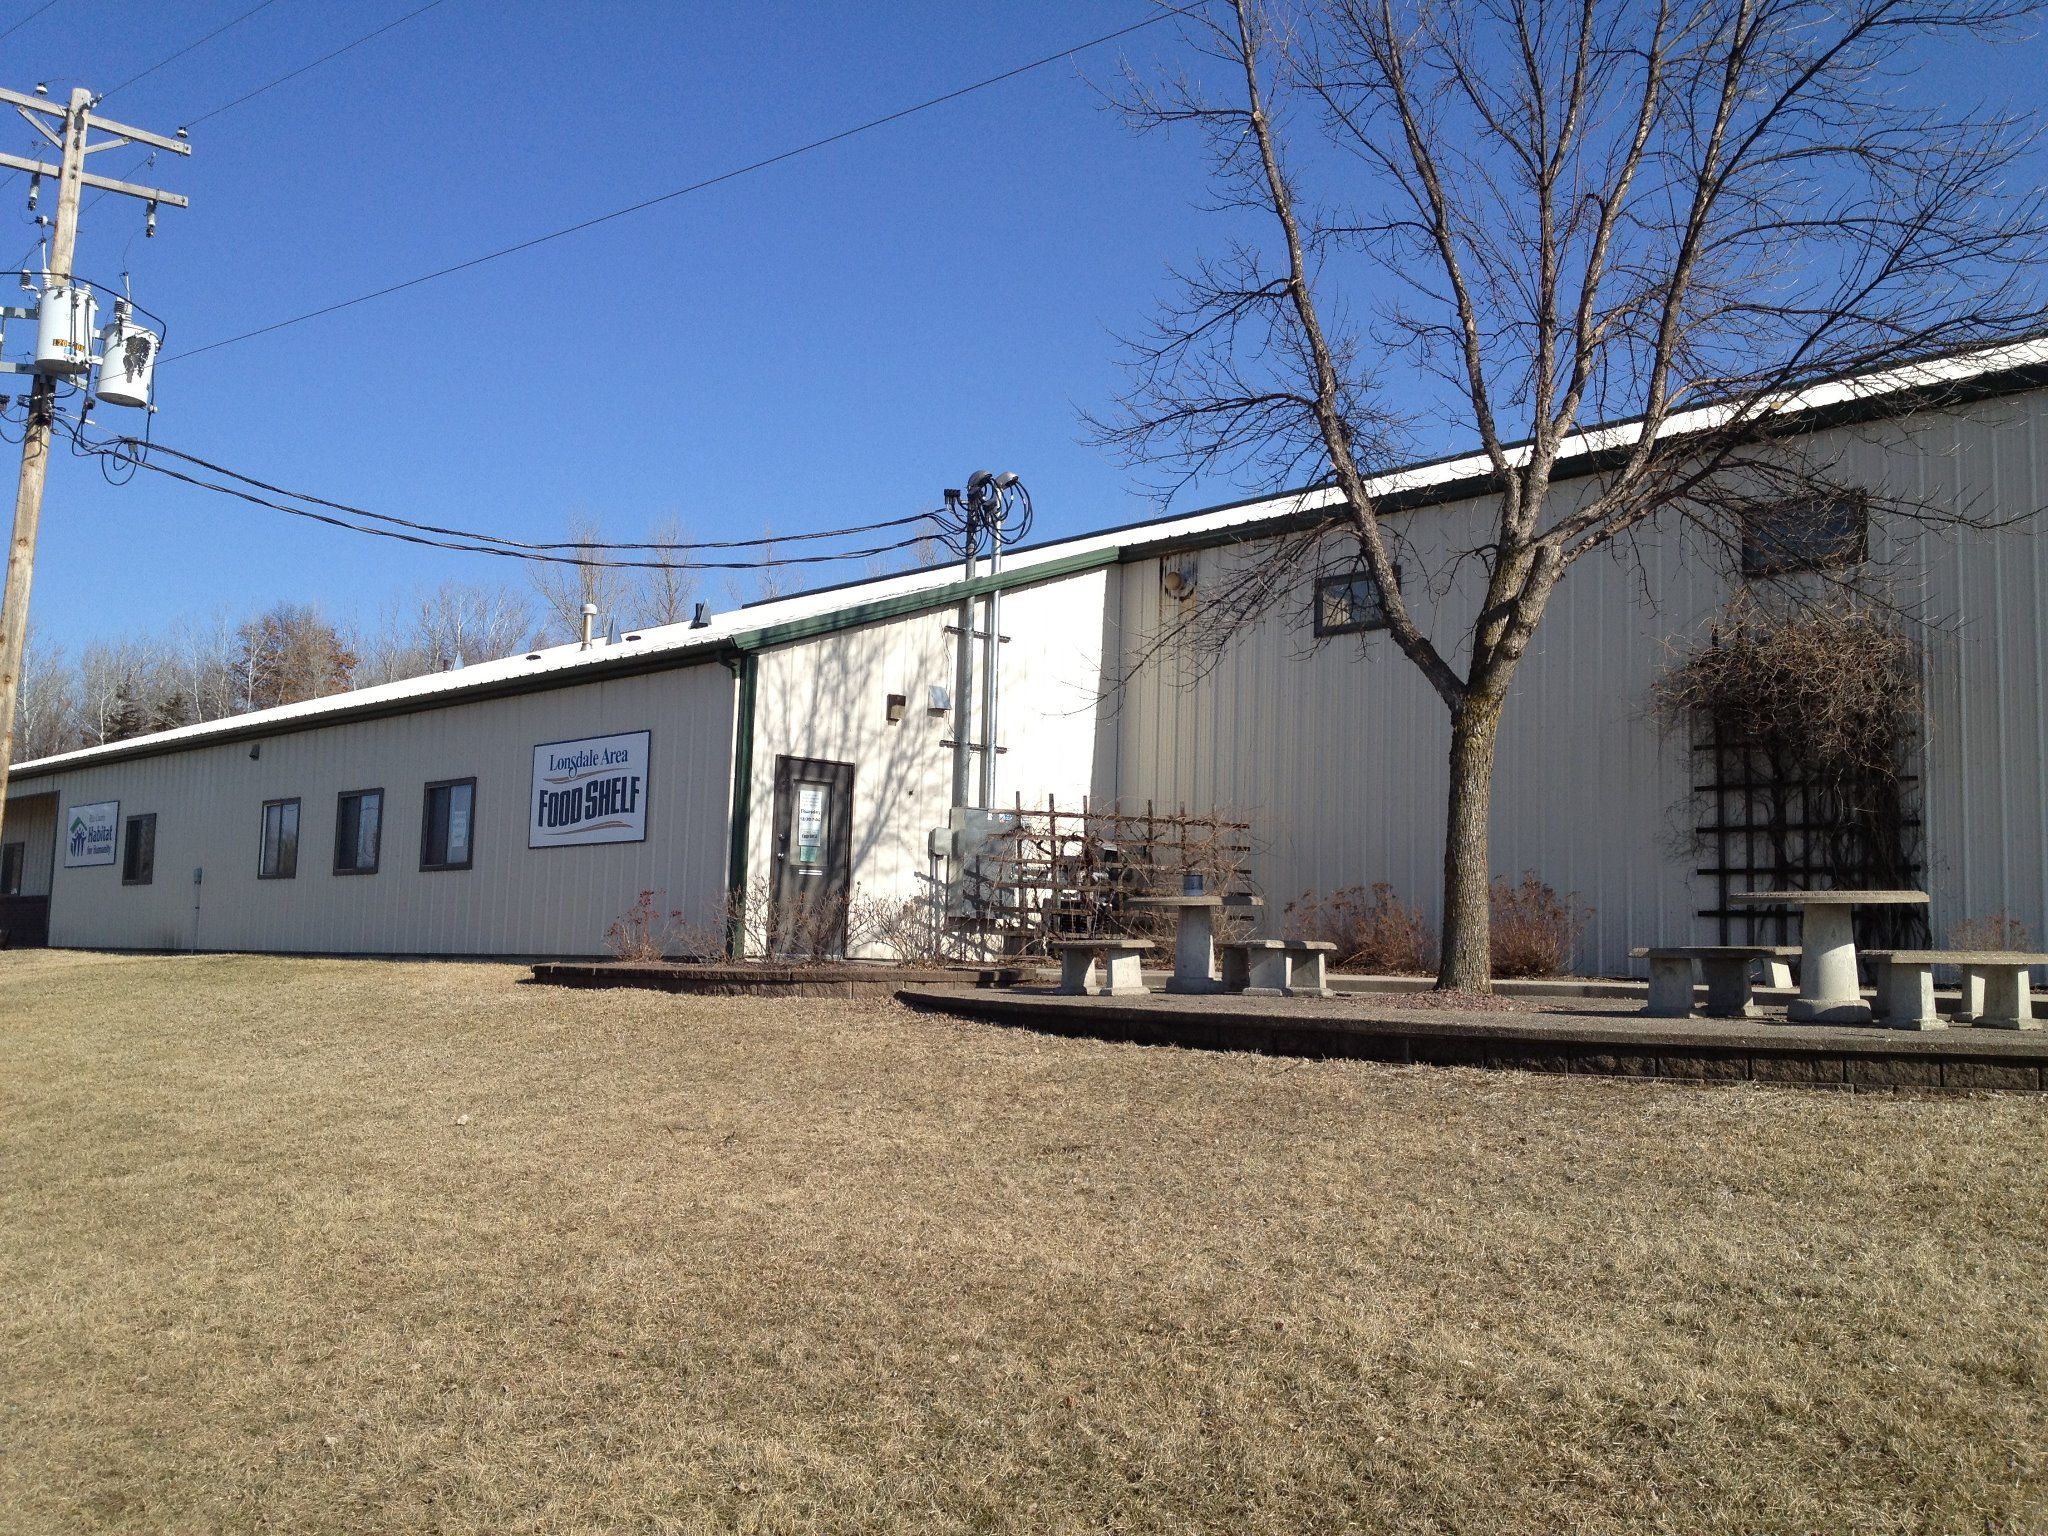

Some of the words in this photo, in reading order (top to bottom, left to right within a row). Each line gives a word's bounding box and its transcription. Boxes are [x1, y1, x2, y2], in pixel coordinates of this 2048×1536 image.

[549, 749, 599, 778] Lonsdale
[601, 747, 628, 766] Area
[538, 786, 583, 828] FOOD
[584, 776, 640, 820] SHELF
[88, 825, 112, 843] Habitat
